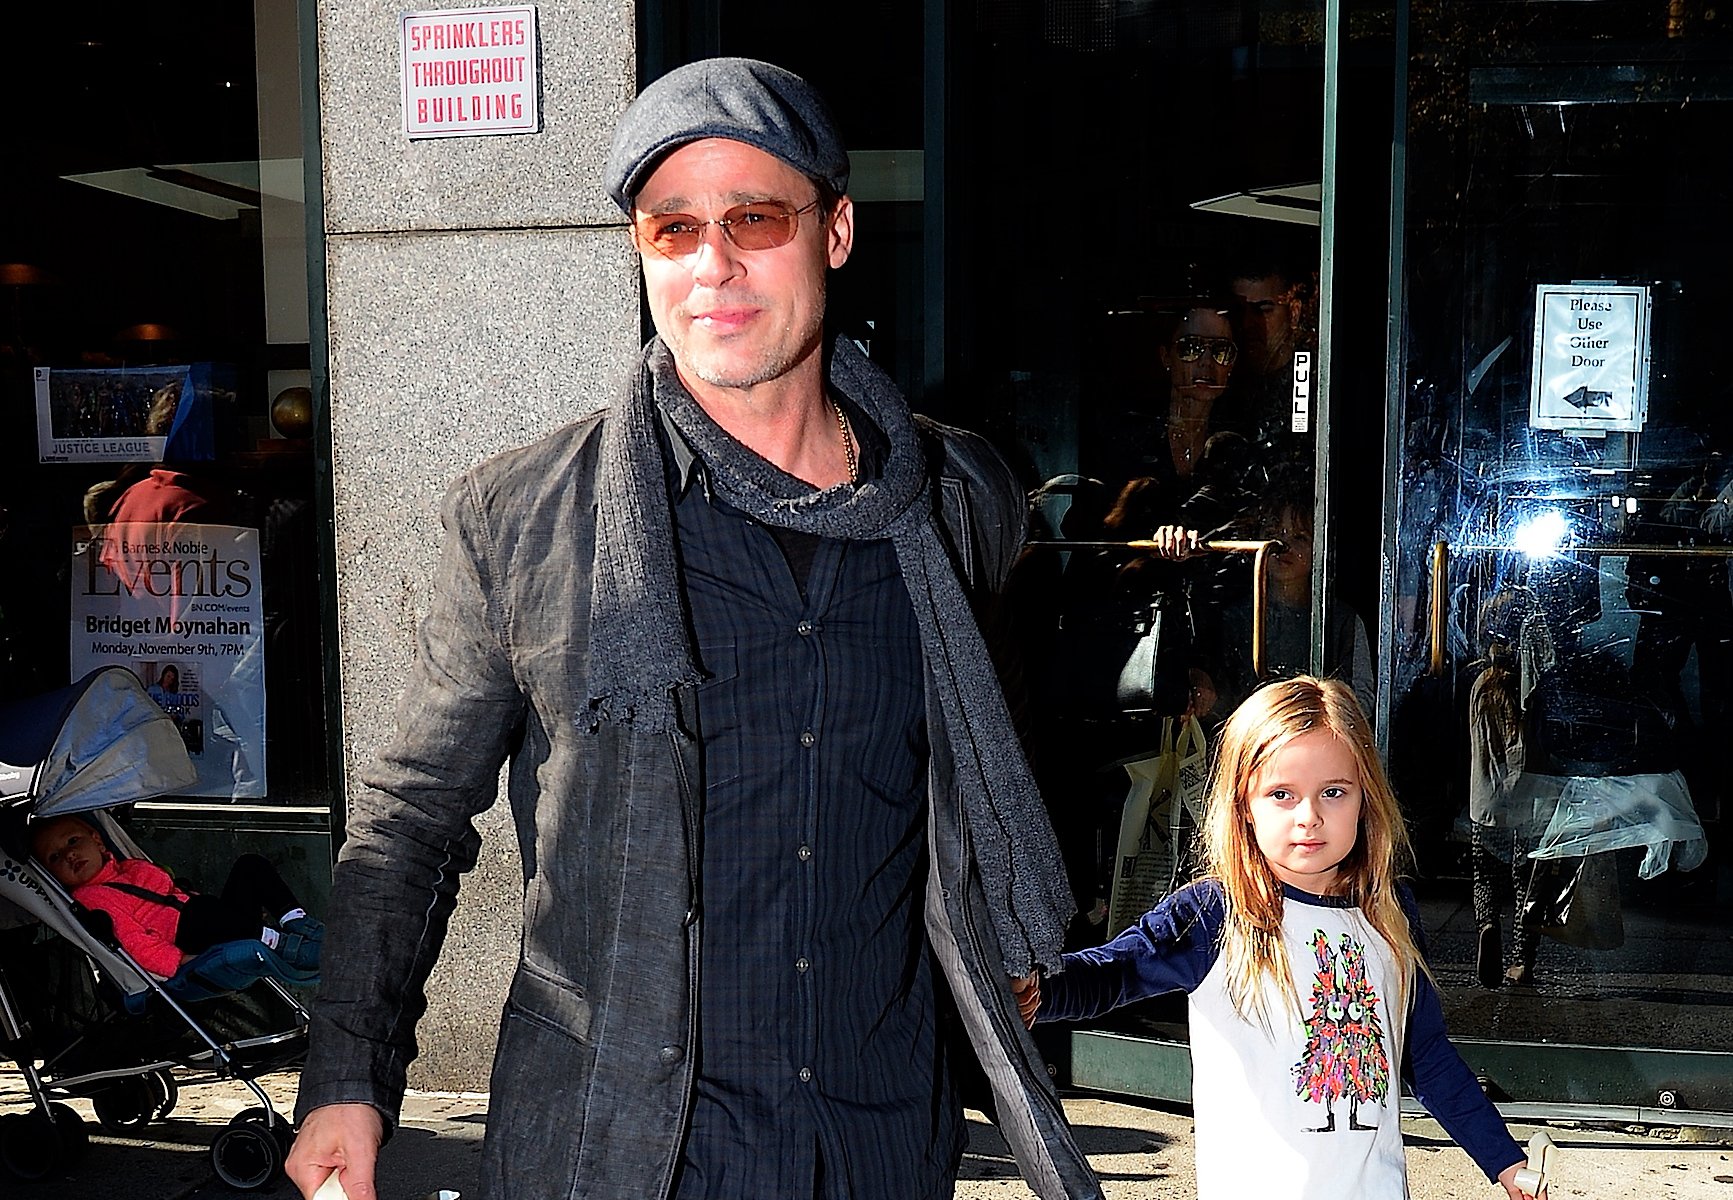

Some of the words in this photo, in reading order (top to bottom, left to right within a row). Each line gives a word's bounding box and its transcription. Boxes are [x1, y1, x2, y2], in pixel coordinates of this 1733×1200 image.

[411, 19, 525, 51] SPRINKLERS
[412, 56, 525, 87] THROUGHOUT
[417, 93, 522, 124] BUILDING
[1570, 298, 1612, 312] Please
[1577, 317, 1603, 330] Use
[1570, 336, 1609, 349] Other
[1571, 355, 1605, 367] Door
[1294, 354, 1308, 414] PULL
[52, 442, 99, 454] JUSTICE
[103, 442, 150, 453] LEAGUE
[122, 541, 160, 554] Barnes
[162, 541, 172, 554] &
[173, 541, 208, 554] Noble
[81, 538, 252, 598] Events
[86, 615, 151, 638] Bridget
[155, 616, 251, 639] Moynahan
[92, 641, 138, 656] Monday,
[138, 642, 195, 655] November
[197, 643, 218, 656] 9th,
[220, 643, 244, 655] 7PM
